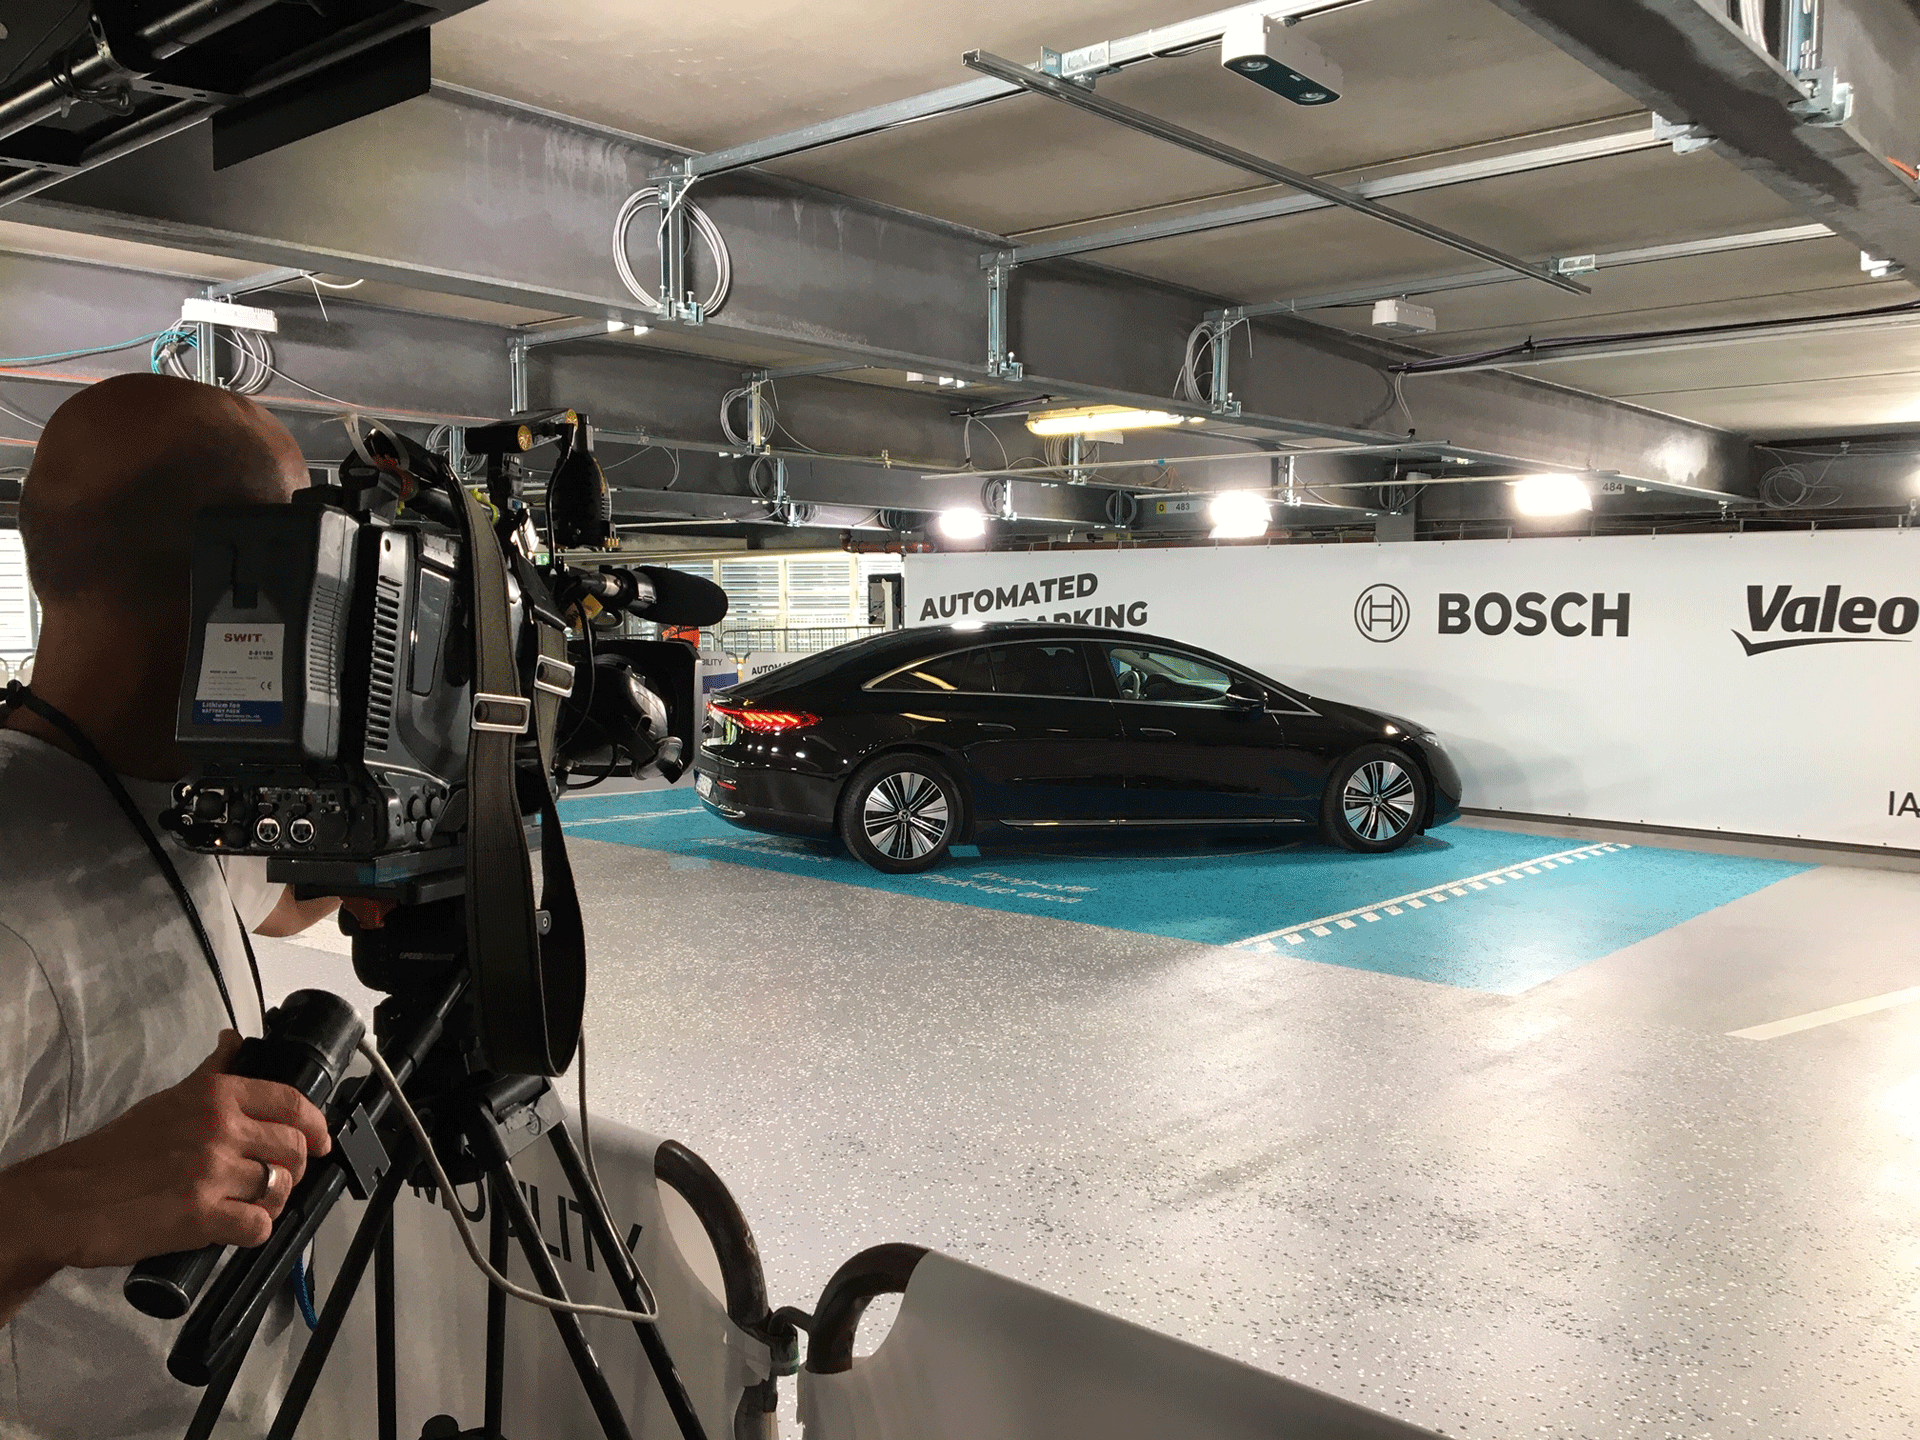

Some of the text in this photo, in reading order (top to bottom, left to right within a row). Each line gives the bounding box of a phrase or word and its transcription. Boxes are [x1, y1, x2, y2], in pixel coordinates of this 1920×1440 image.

[1602, 482, 1623, 492] 484
[1175, 502, 1190, 511] 483
[919, 572, 1098, 622] AUTOMATED
[1746, 584, 1919, 635] Valeo
[1013, 601, 1148, 629] RKING
[1438, 591, 1631, 637] BOSCH
[223, 632, 263, 643] SWIT
